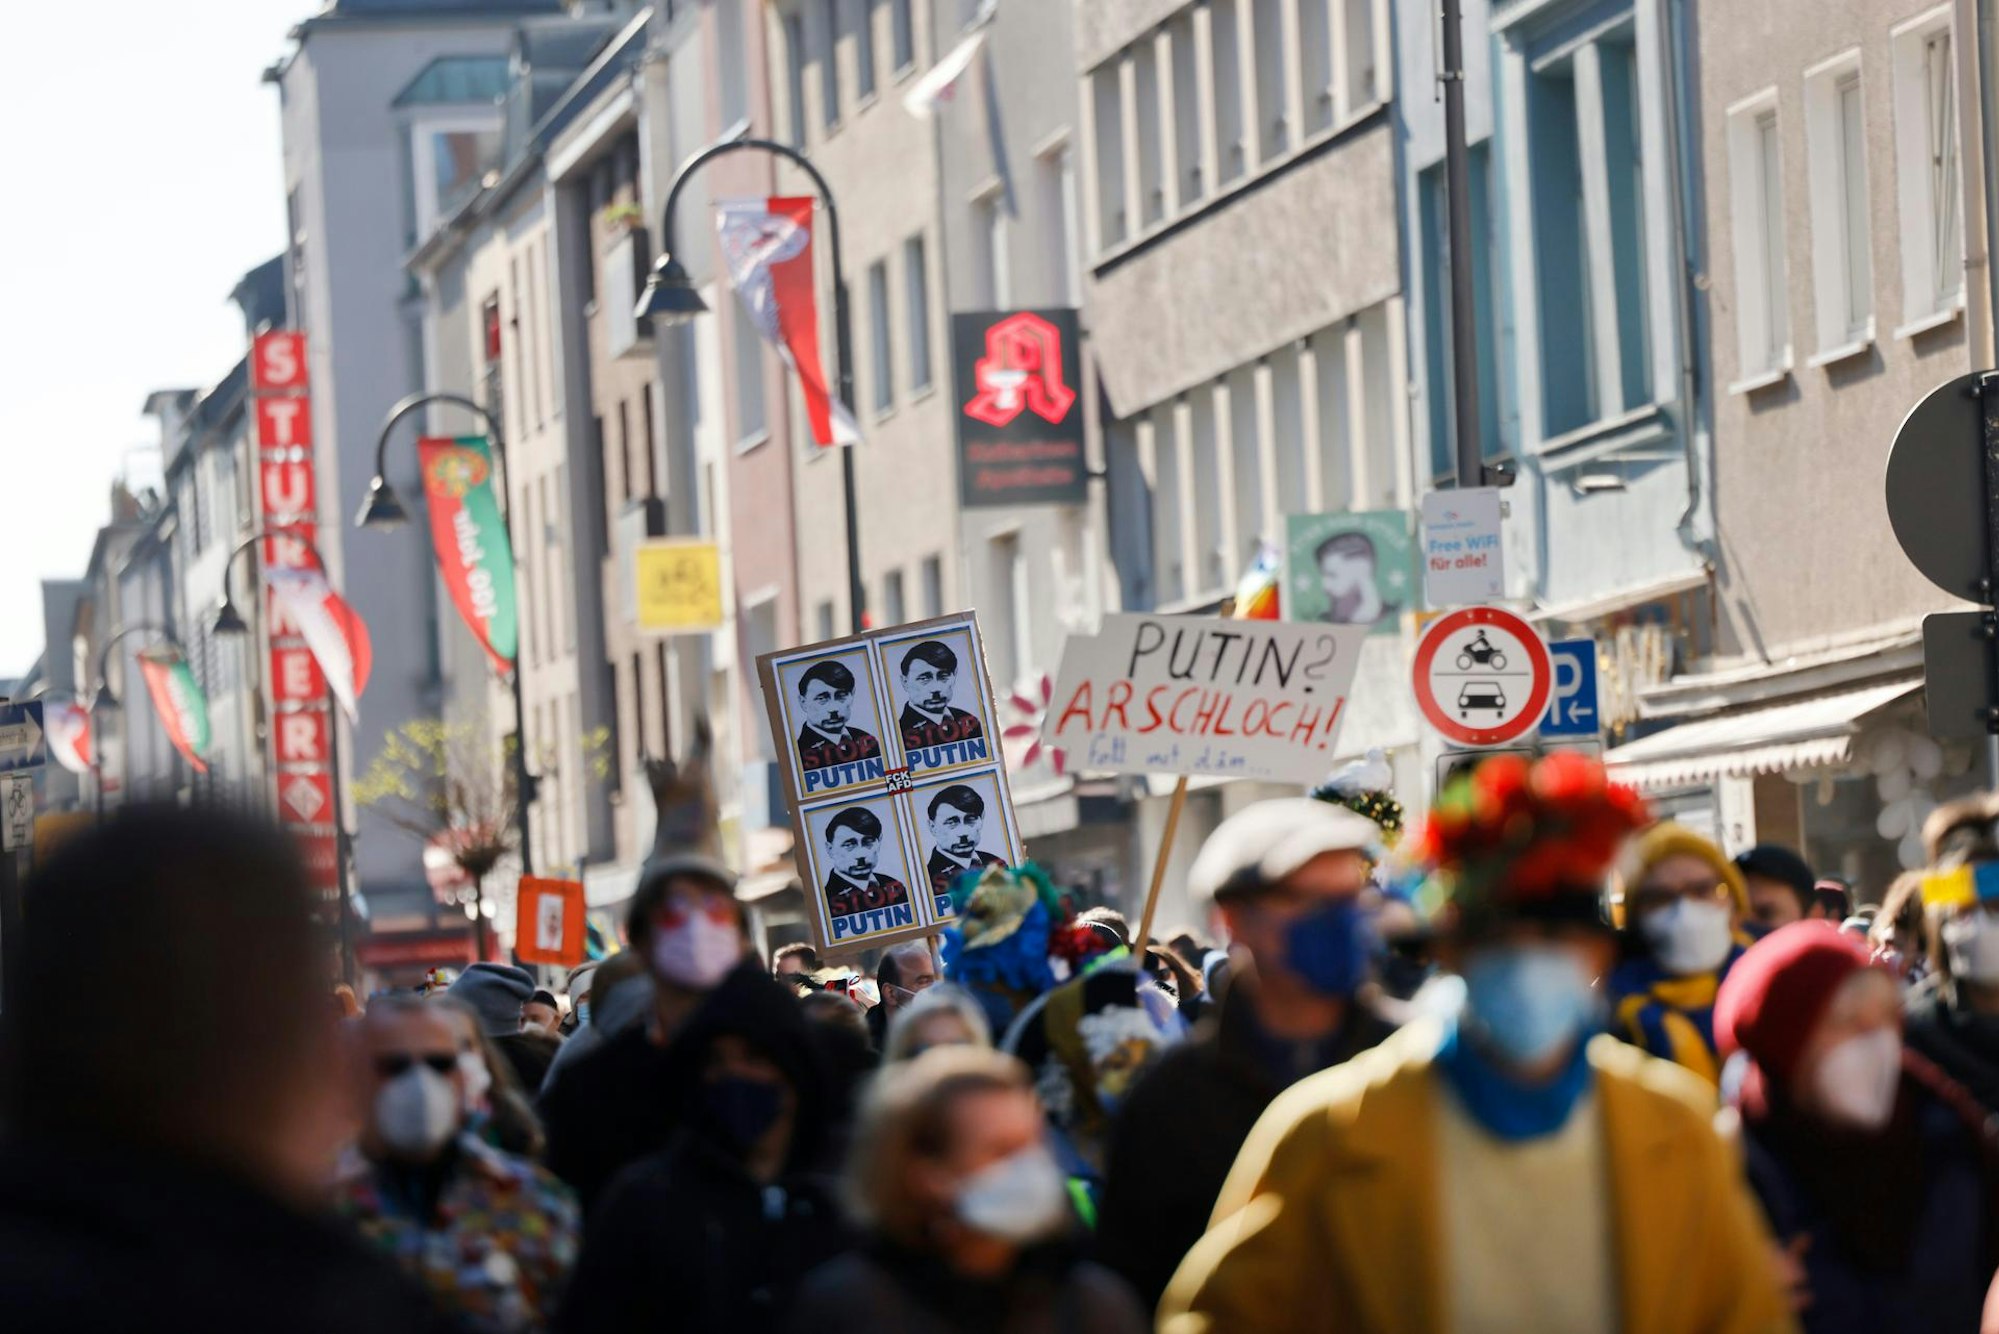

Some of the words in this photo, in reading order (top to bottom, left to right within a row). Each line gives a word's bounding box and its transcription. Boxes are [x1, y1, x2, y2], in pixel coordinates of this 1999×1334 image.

[1430, 540, 1462, 552] Free
[1455, 553, 1487, 569] alle!
[1128, 622, 1337, 693] PUTIN?
[1054, 679, 1345, 750] ARSCHLOCH!
[903, 714, 978, 751] STOP
[803, 735, 878, 771] STOP
[905, 738, 987, 772] PUTIN
[804, 757, 885, 792] PUTIN
[886, 770, 909, 783] FCK
[888, 780, 912, 792] AFD
[830, 880, 905, 916] STOP
[831, 903, 913, 939] PUTIN
